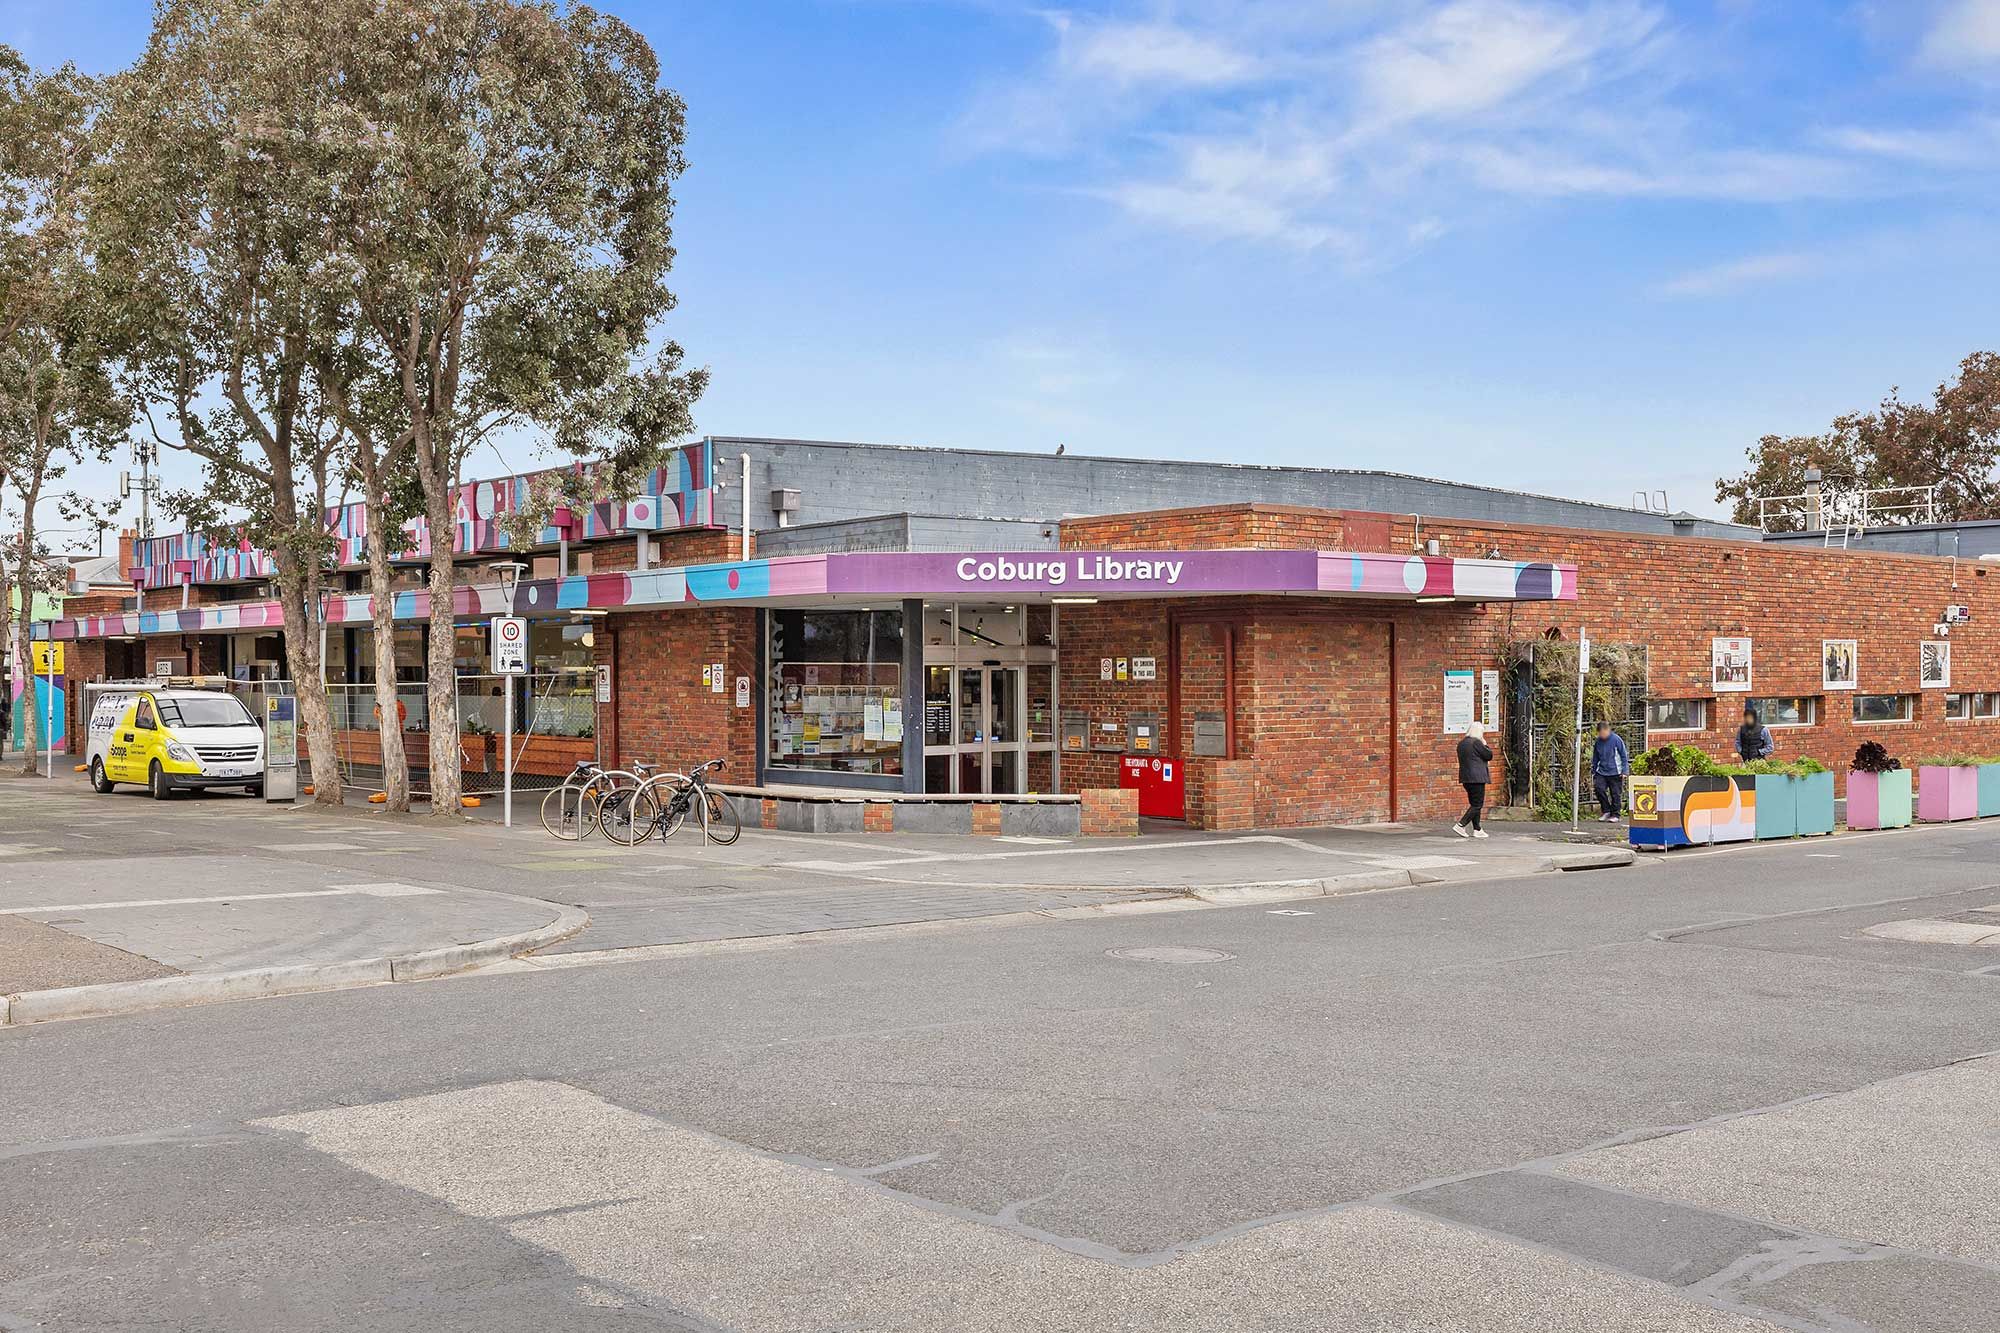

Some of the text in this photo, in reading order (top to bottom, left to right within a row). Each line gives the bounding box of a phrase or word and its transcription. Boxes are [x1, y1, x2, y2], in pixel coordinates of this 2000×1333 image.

[956, 556, 1184, 585] Coburg Library
[506, 627, 515, 636] 10
